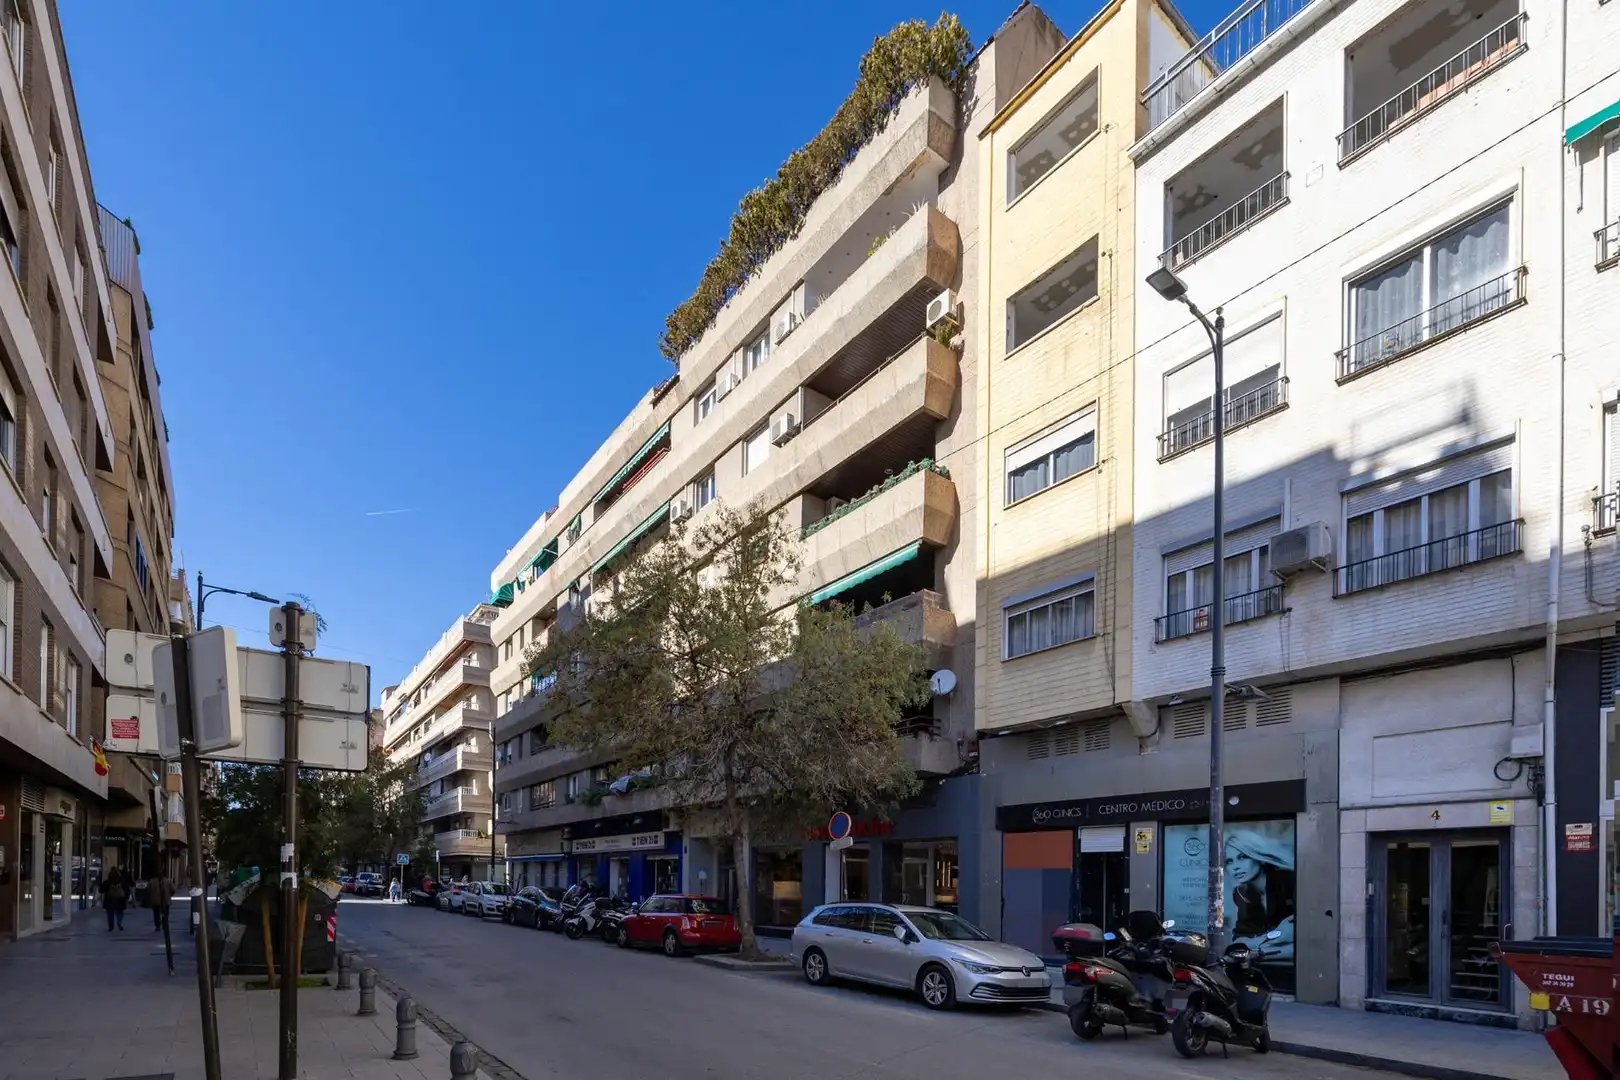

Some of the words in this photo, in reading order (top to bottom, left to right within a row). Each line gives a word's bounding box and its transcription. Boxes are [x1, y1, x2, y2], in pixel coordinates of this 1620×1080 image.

[1098, 802, 1138, 815] CENTRO
[1430, 810, 1440, 820] 4
[1542, 973, 1575, 982] TEGUI
[1556, 995, 1573, 1012] A
[1580, 999, 1610, 1016] 19
